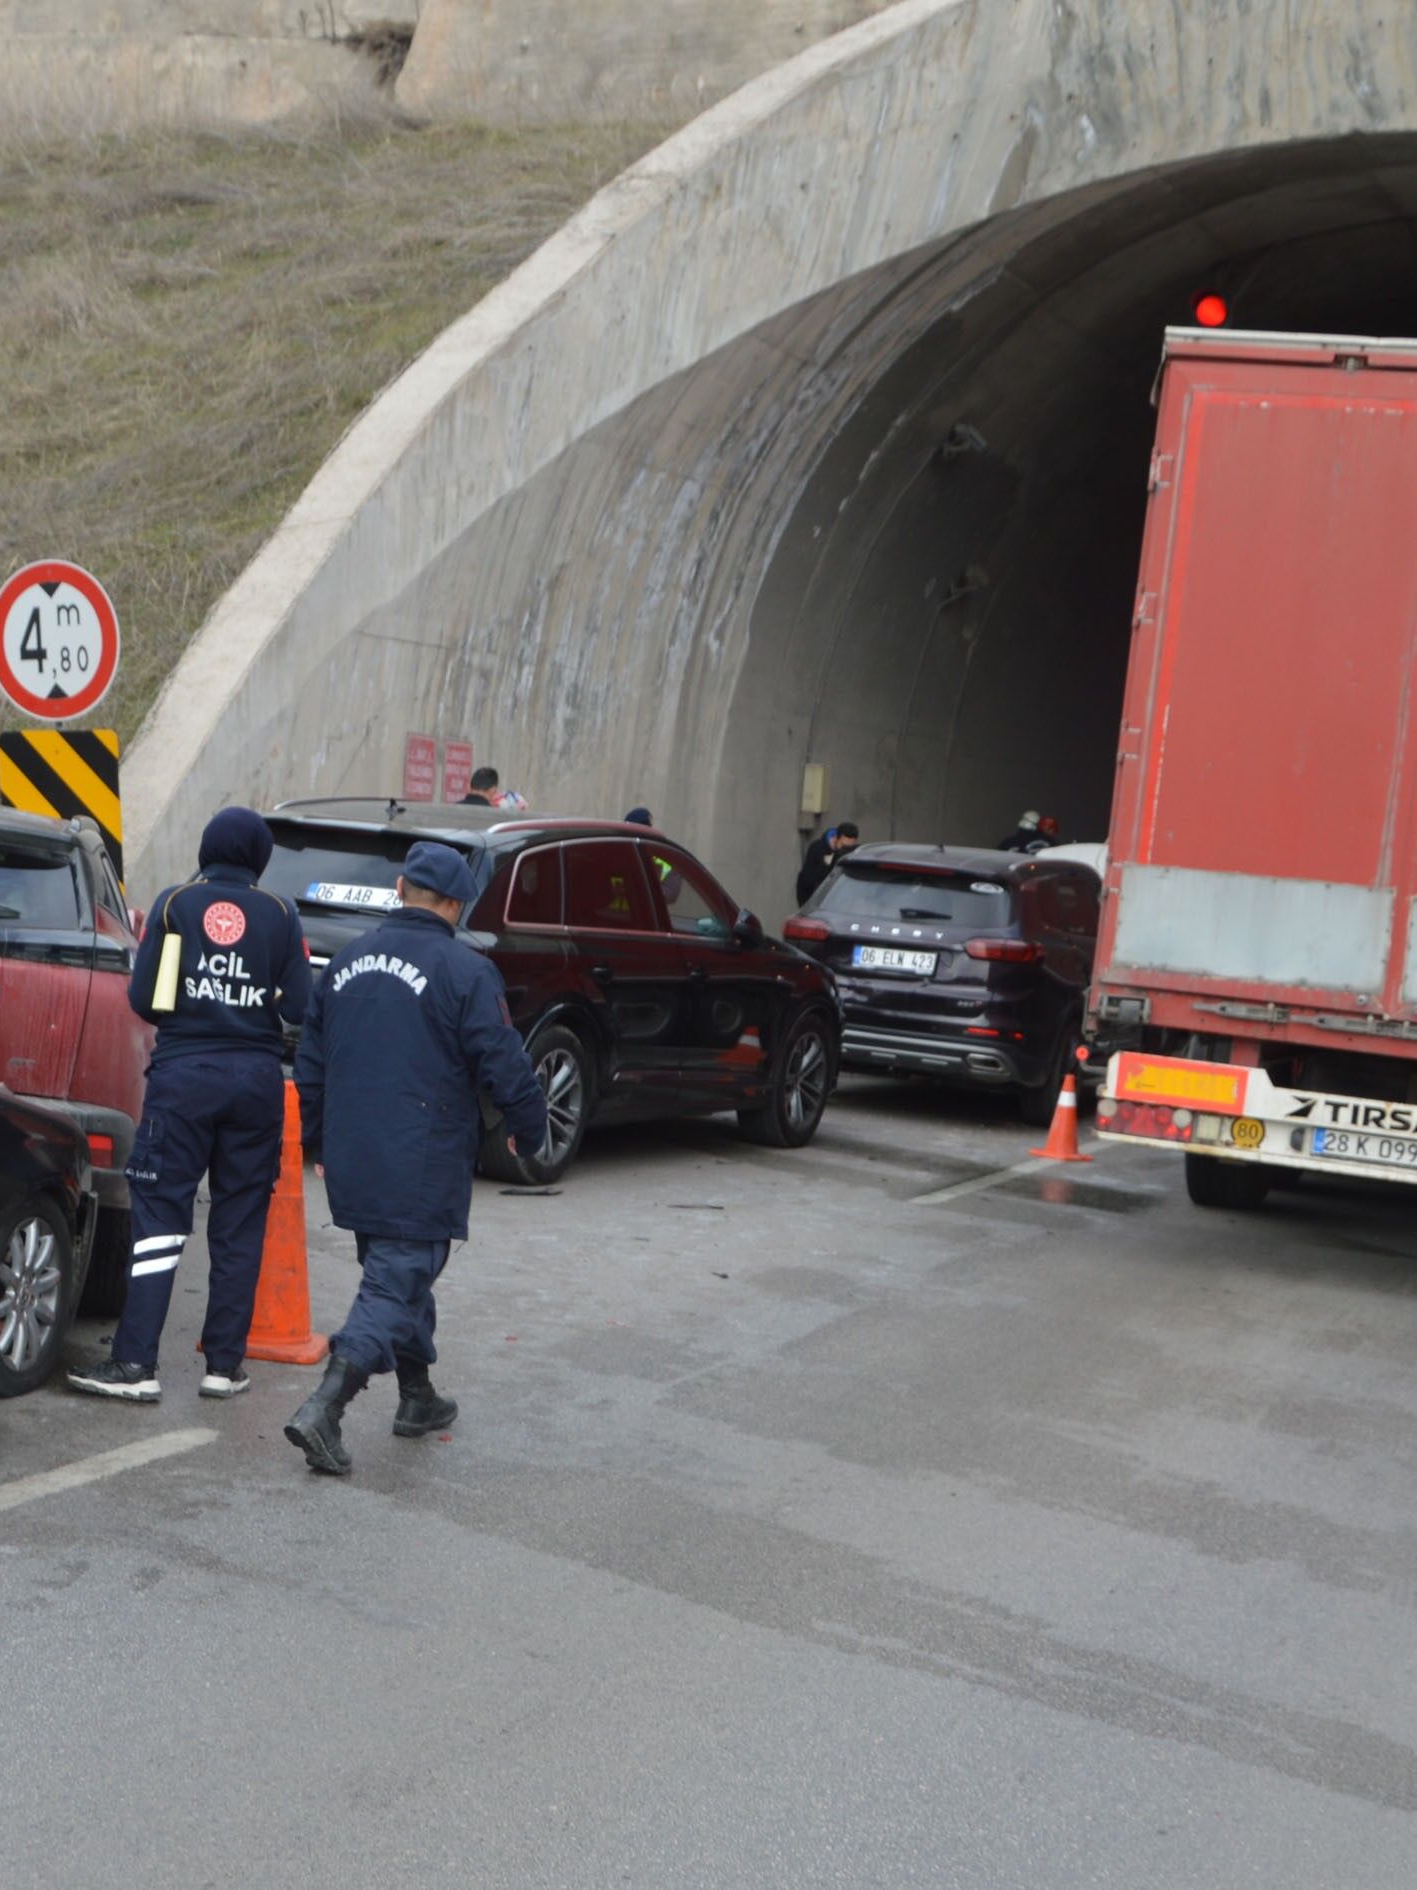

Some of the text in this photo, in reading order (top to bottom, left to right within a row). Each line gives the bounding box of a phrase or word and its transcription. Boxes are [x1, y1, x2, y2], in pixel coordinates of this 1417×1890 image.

[56, 603, 80, 626] m
[317, 884, 336, 900] 06
[342, 887, 373, 906] AAB
[197, 951, 251, 979] ACİL
[862, 948, 875, 963] 06
[912, 953, 935, 970] 423
[332, 953, 428, 996] JANDARMA
[185, 976, 267, 1007] SAĞLIK
[1324, 1100, 1417, 1133] TIRS
[1237, 1122, 1259, 1140] 80
[1324, 1132, 1350, 1153] 28
[1356, 1135, 1370, 1155] K
